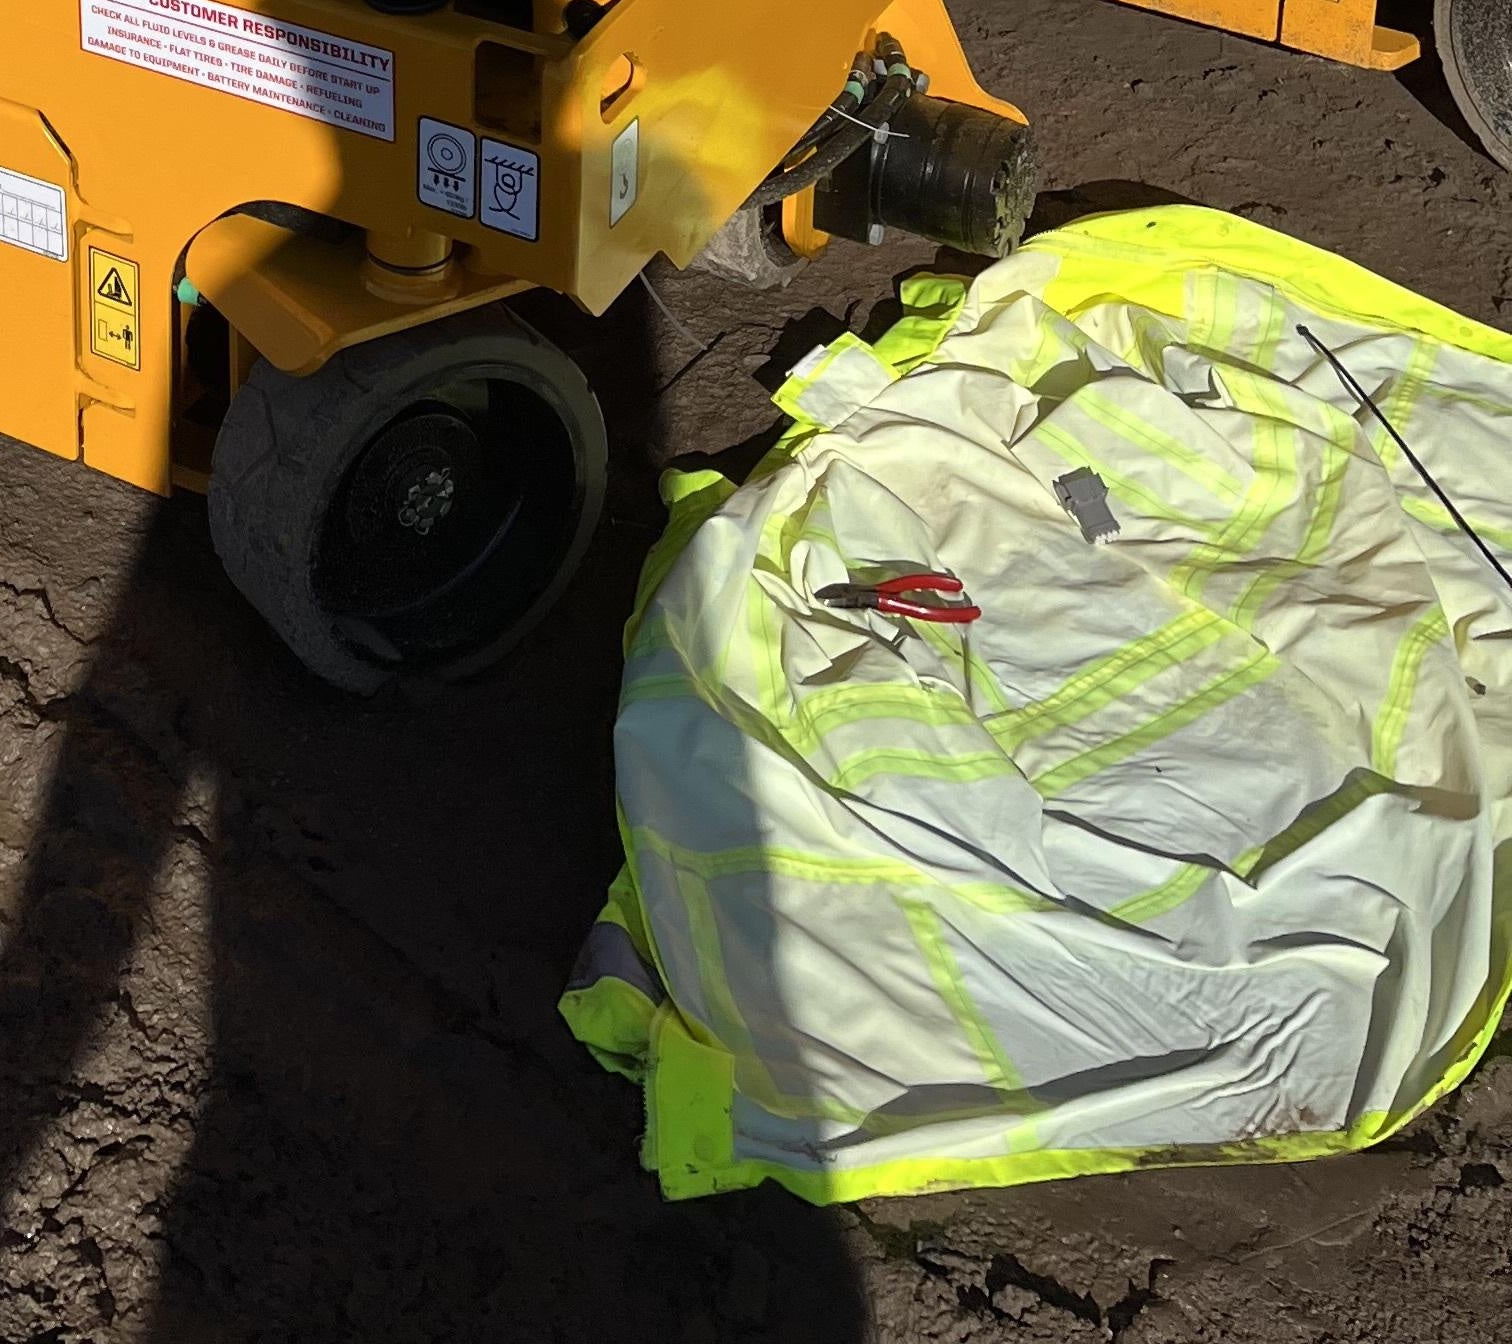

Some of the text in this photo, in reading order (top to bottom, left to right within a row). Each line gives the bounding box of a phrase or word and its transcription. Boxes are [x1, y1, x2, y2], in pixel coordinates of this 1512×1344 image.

[87, 36, 386, 133] DAMAGE TO EQUIPMENT BATTERY MAINTENANCE CLEANING
[91, 4, 122, 21] CHECK
[124, 13, 140, 27] ALL
[142, 17, 170, 35] FLUID
[172, 26, 207, 46] LEVELS
[217, 41, 256, 60] GREASE
[258, 53, 288, 68] DAILY
[289, 62, 329, 82] BEFORE
[331, 74, 363, 92] START
[365, 84, 381, 96] UP
[107, 25, 363, 109] INSURANCE FLAT TIRES TIRE DAMAGE REFUELING
[243, 18, 390, 72] RESPONSIBILITY
